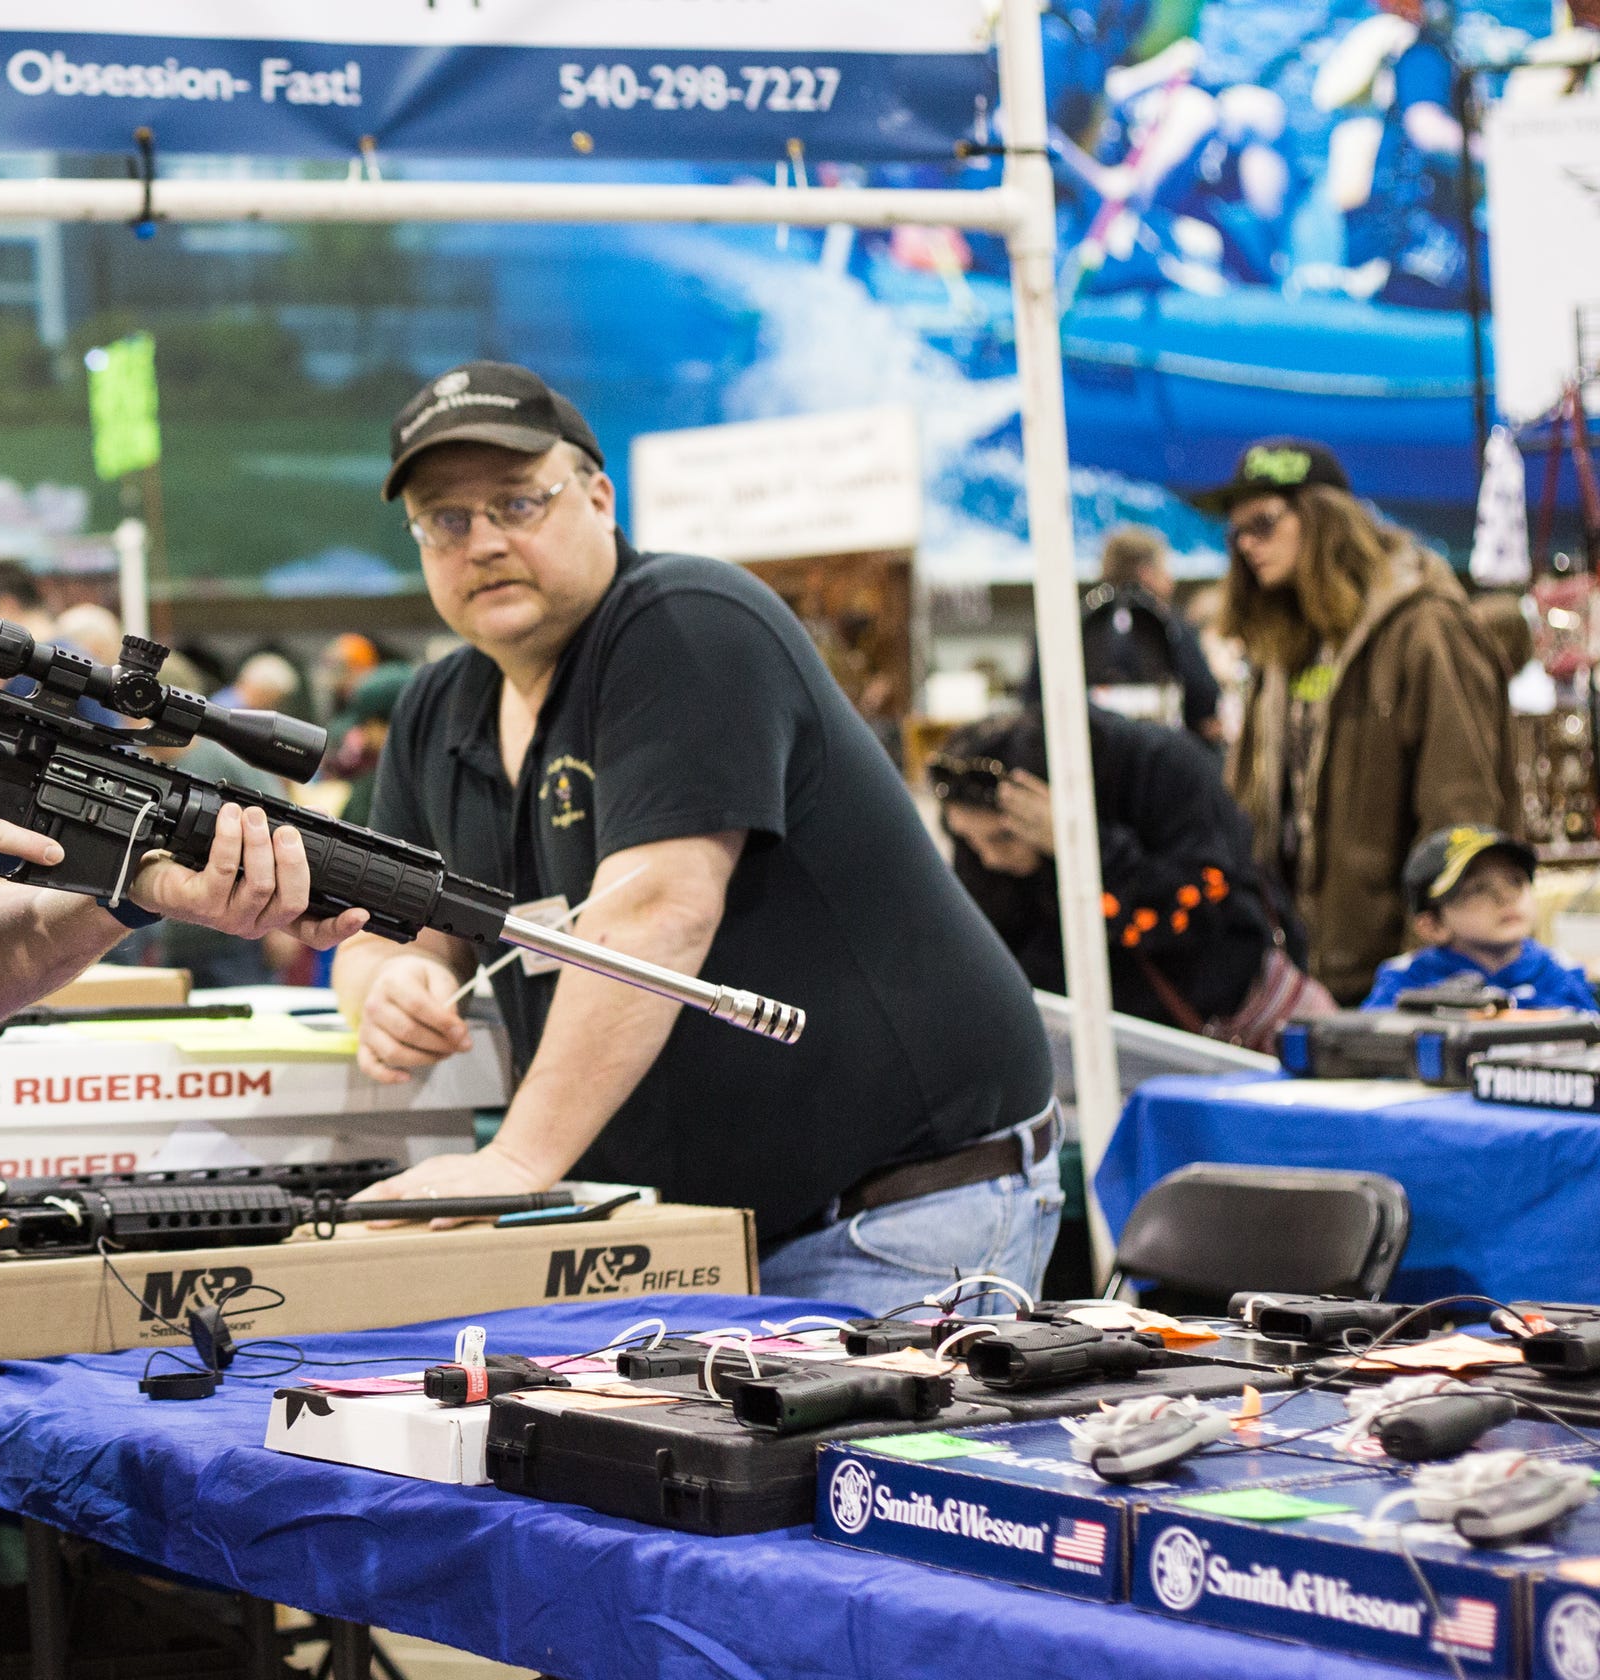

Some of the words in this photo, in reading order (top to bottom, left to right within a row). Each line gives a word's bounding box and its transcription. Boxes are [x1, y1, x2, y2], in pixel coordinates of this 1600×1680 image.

[6, 50, 250, 101] Obsession-
[260, 57, 362, 106] Fast!
[558, 63, 841, 113] 540-298-7227
[14, 1070, 272, 1105] RUGER.COM
[1473, 1063, 1595, 1108] TAURUS
[139, 1266, 253, 1321] M&P
[545, 1245, 651, 1298] M&P
[642, 1266, 721, 1291] RIFLES
[873, 1484, 1045, 1554] Smith&Wesson
[1205, 1555, 1422, 1637] Smith&Wesson
